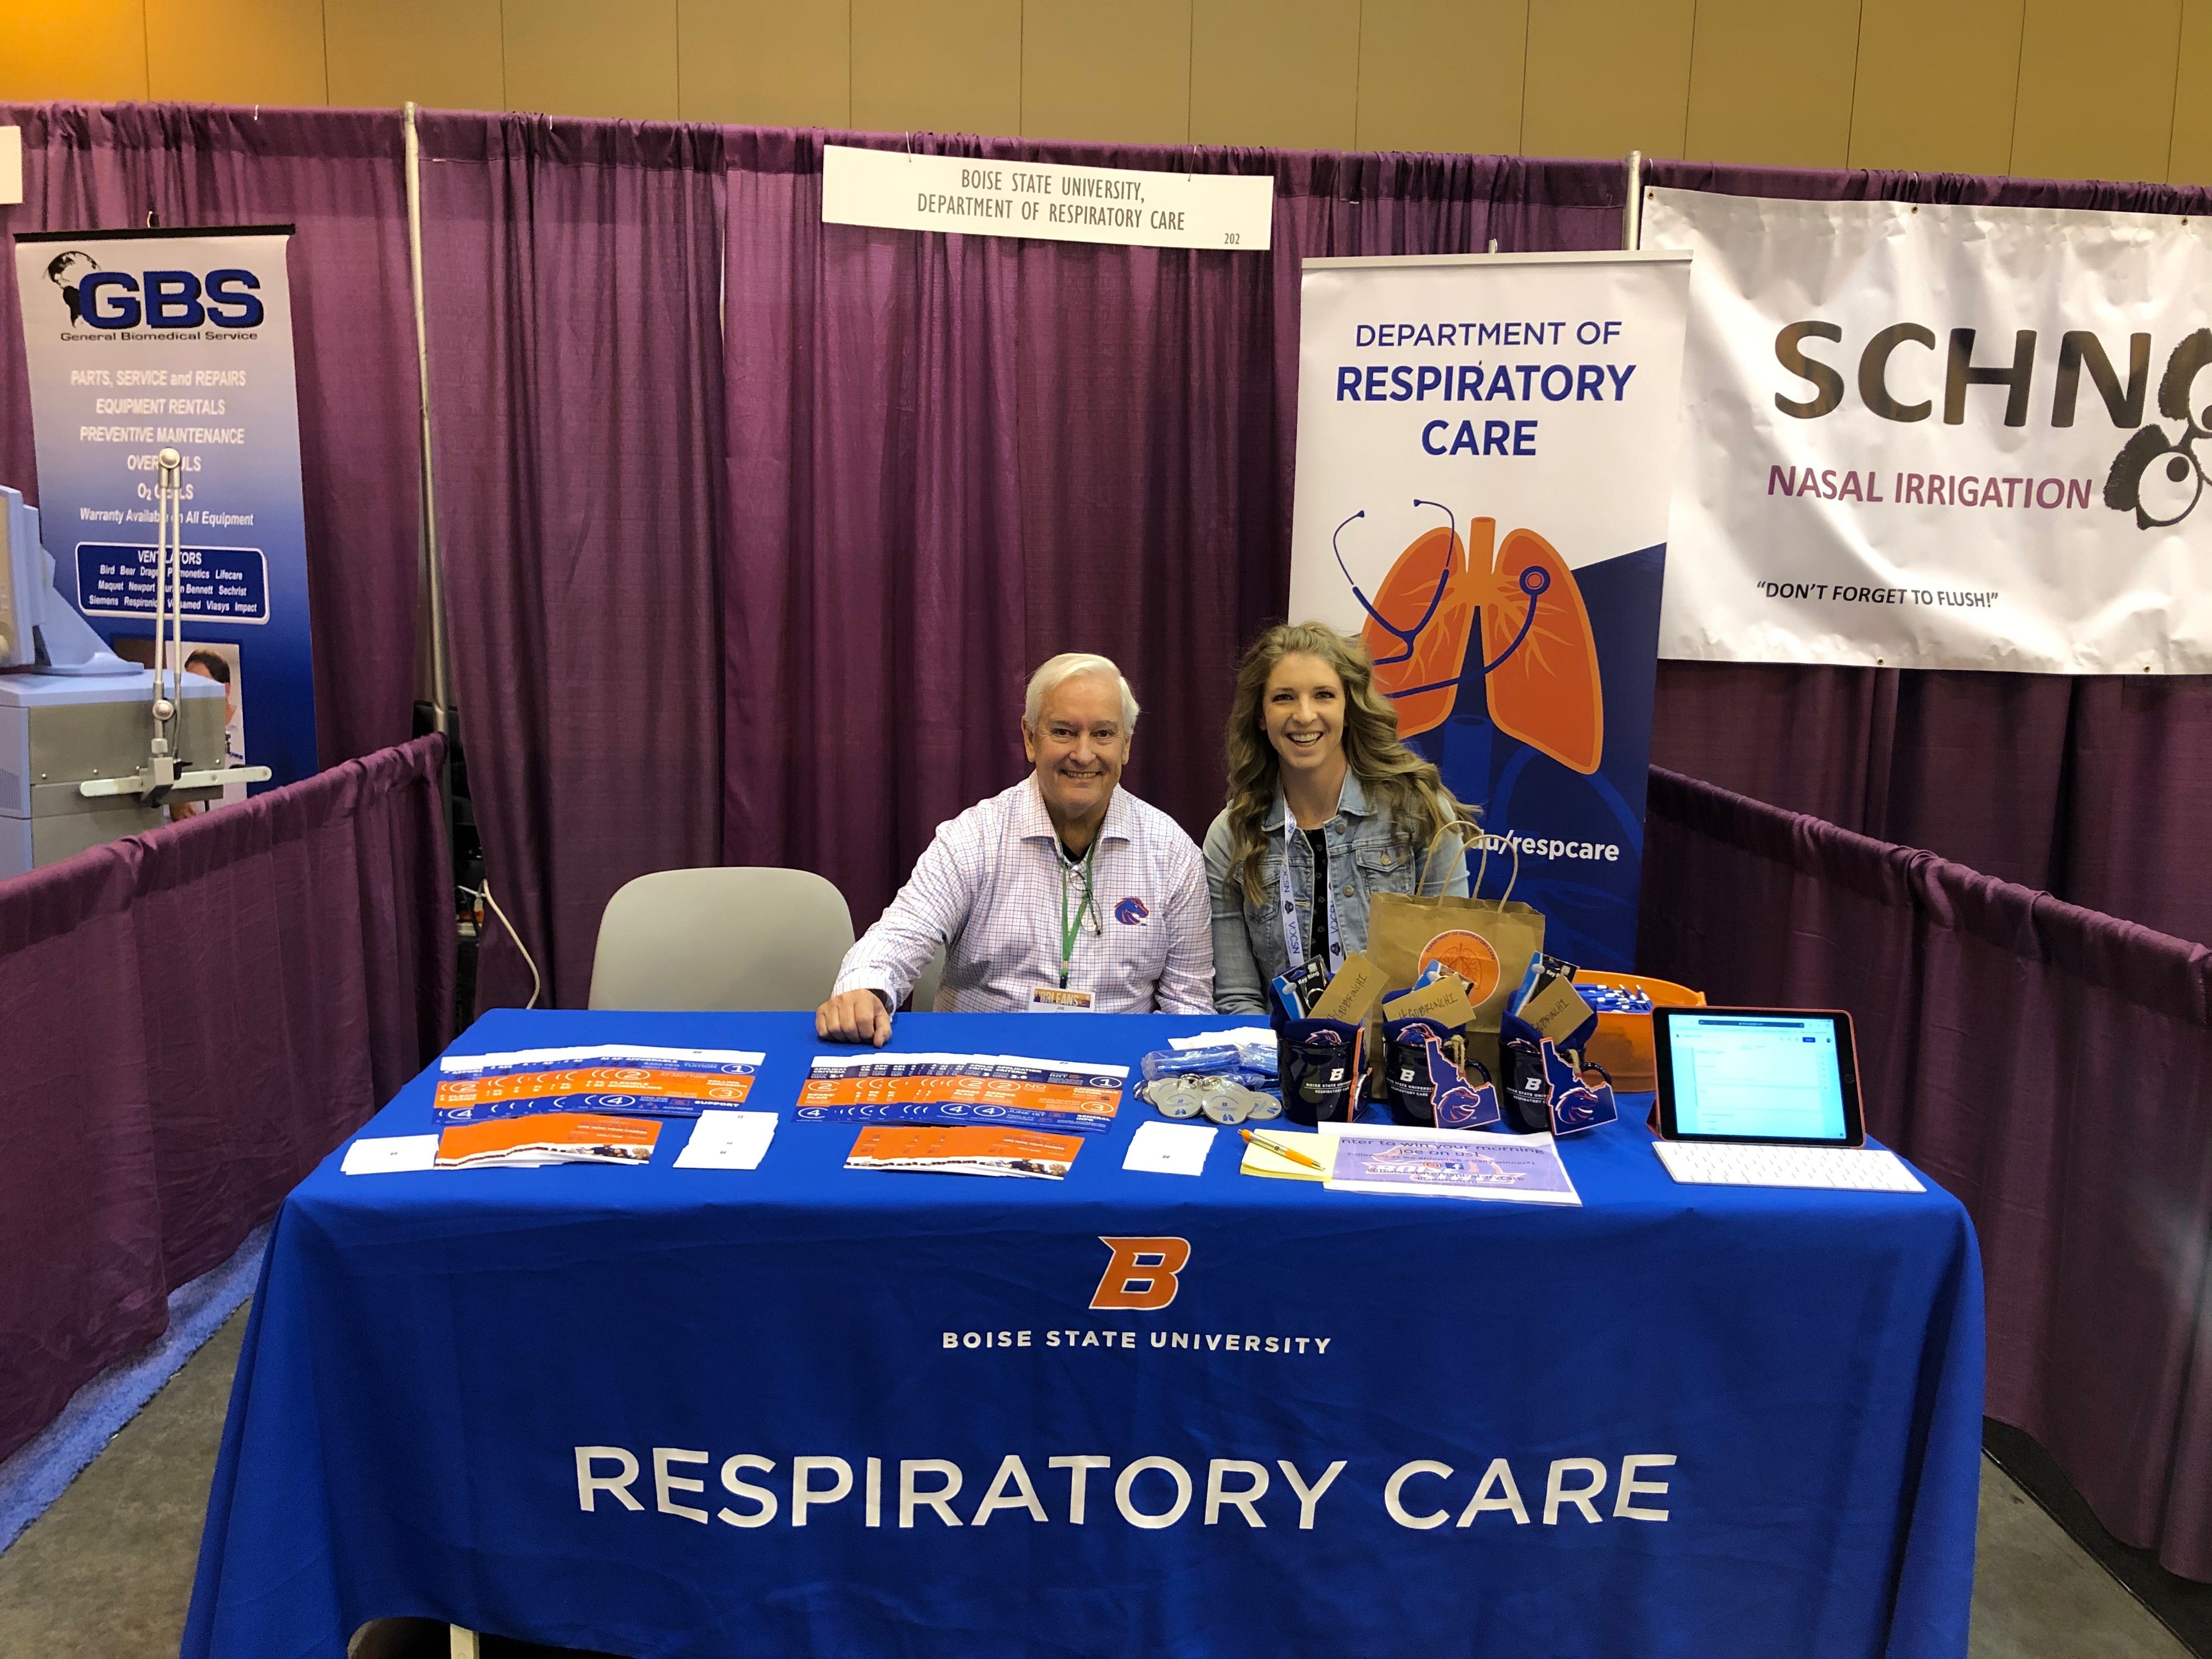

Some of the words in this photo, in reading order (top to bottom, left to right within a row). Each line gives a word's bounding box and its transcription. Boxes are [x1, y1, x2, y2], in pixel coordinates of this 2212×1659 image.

[961, 168, 1002, 191] BOISE
[1011, 172, 1052, 195] STATE
[1062, 176, 1146, 204] UNIVERSITY,
[917, 193, 1013, 221] DEPARTMENT
[1022, 201, 1039, 222] OF
[1049, 203, 1142, 230] RESPIRATORY
[1150, 210, 1185, 232] CARE
[1224, 233, 1240, 245] 202
[78, 269, 264, 330] GBS
[60, 332, 116, 342] General
[121, 331, 201, 341] Biomedical
[205, 331, 258, 341] Service
[1356, 322, 1566, 347] DEPARTMENT
[1576, 321, 1622, 346] OF
[71, 370, 112, 388] PARTS,
[116, 370, 167, 386] SERVICE
[170, 371, 193, 386] and
[195, 370, 246, 386] REPAIRS
[1336, 364, 1637, 402] RESPIRATORY
[96, 398, 166, 415] EQUIPMENT
[168, 399, 225, 415] RENTALS
[80, 426, 154, 442] PREVENTIVE
[156, 427, 245, 444] MAINTENANCE
[1421, 419, 1538, 457] CARE
[1768, 464, 1884, 504] NASAL
[1895, 472, 2092, 510] IRRIGATION
[80, 507, 125, 524] Warranty
[185, 511, 199, 523] All
[201, 511, 254, 528] Equipment
[215, 569, 243, 581] Lifecare
[98, 580, 124, 593] Maquet
[128, 581, 155, 594] Newport
[185, 584, 213, 595] Bennett
[218, 585, 247, 597] Sechrist
[1832, 585, 1907, 605] FORGET
[1911, 589, 1933, 606] TO
[88, 594, 119, 606] Siemens
[206, 600, 230, 612] Viasys
[234, 601, 257, 614] Impact
[1297, 976, 1308, 985] Key
[1306, 969, 1320, 980] Ring
[1099, 1079, 1113, 1087] 1
[1329, 1068, 1344, 1081] B
[1400, 1068, 1415, 1082] B
[1525, 1077, 1542, 1091] B
[610, 1097, 623, 1105] 4
[1090, 1103, 1104, 1111] 3
[1088, 1235, 1192, 1311] B
[943, 1330, 1031, 1349] BOISE
[1046, 1330, 1137, 1350] STATE
[1150, 1331, 1332, 1355] UNIVERSITY
[574, 1445, 1348, 1531] RESPIRATORY
[1384, 1453, 1678, 1530] CARE
